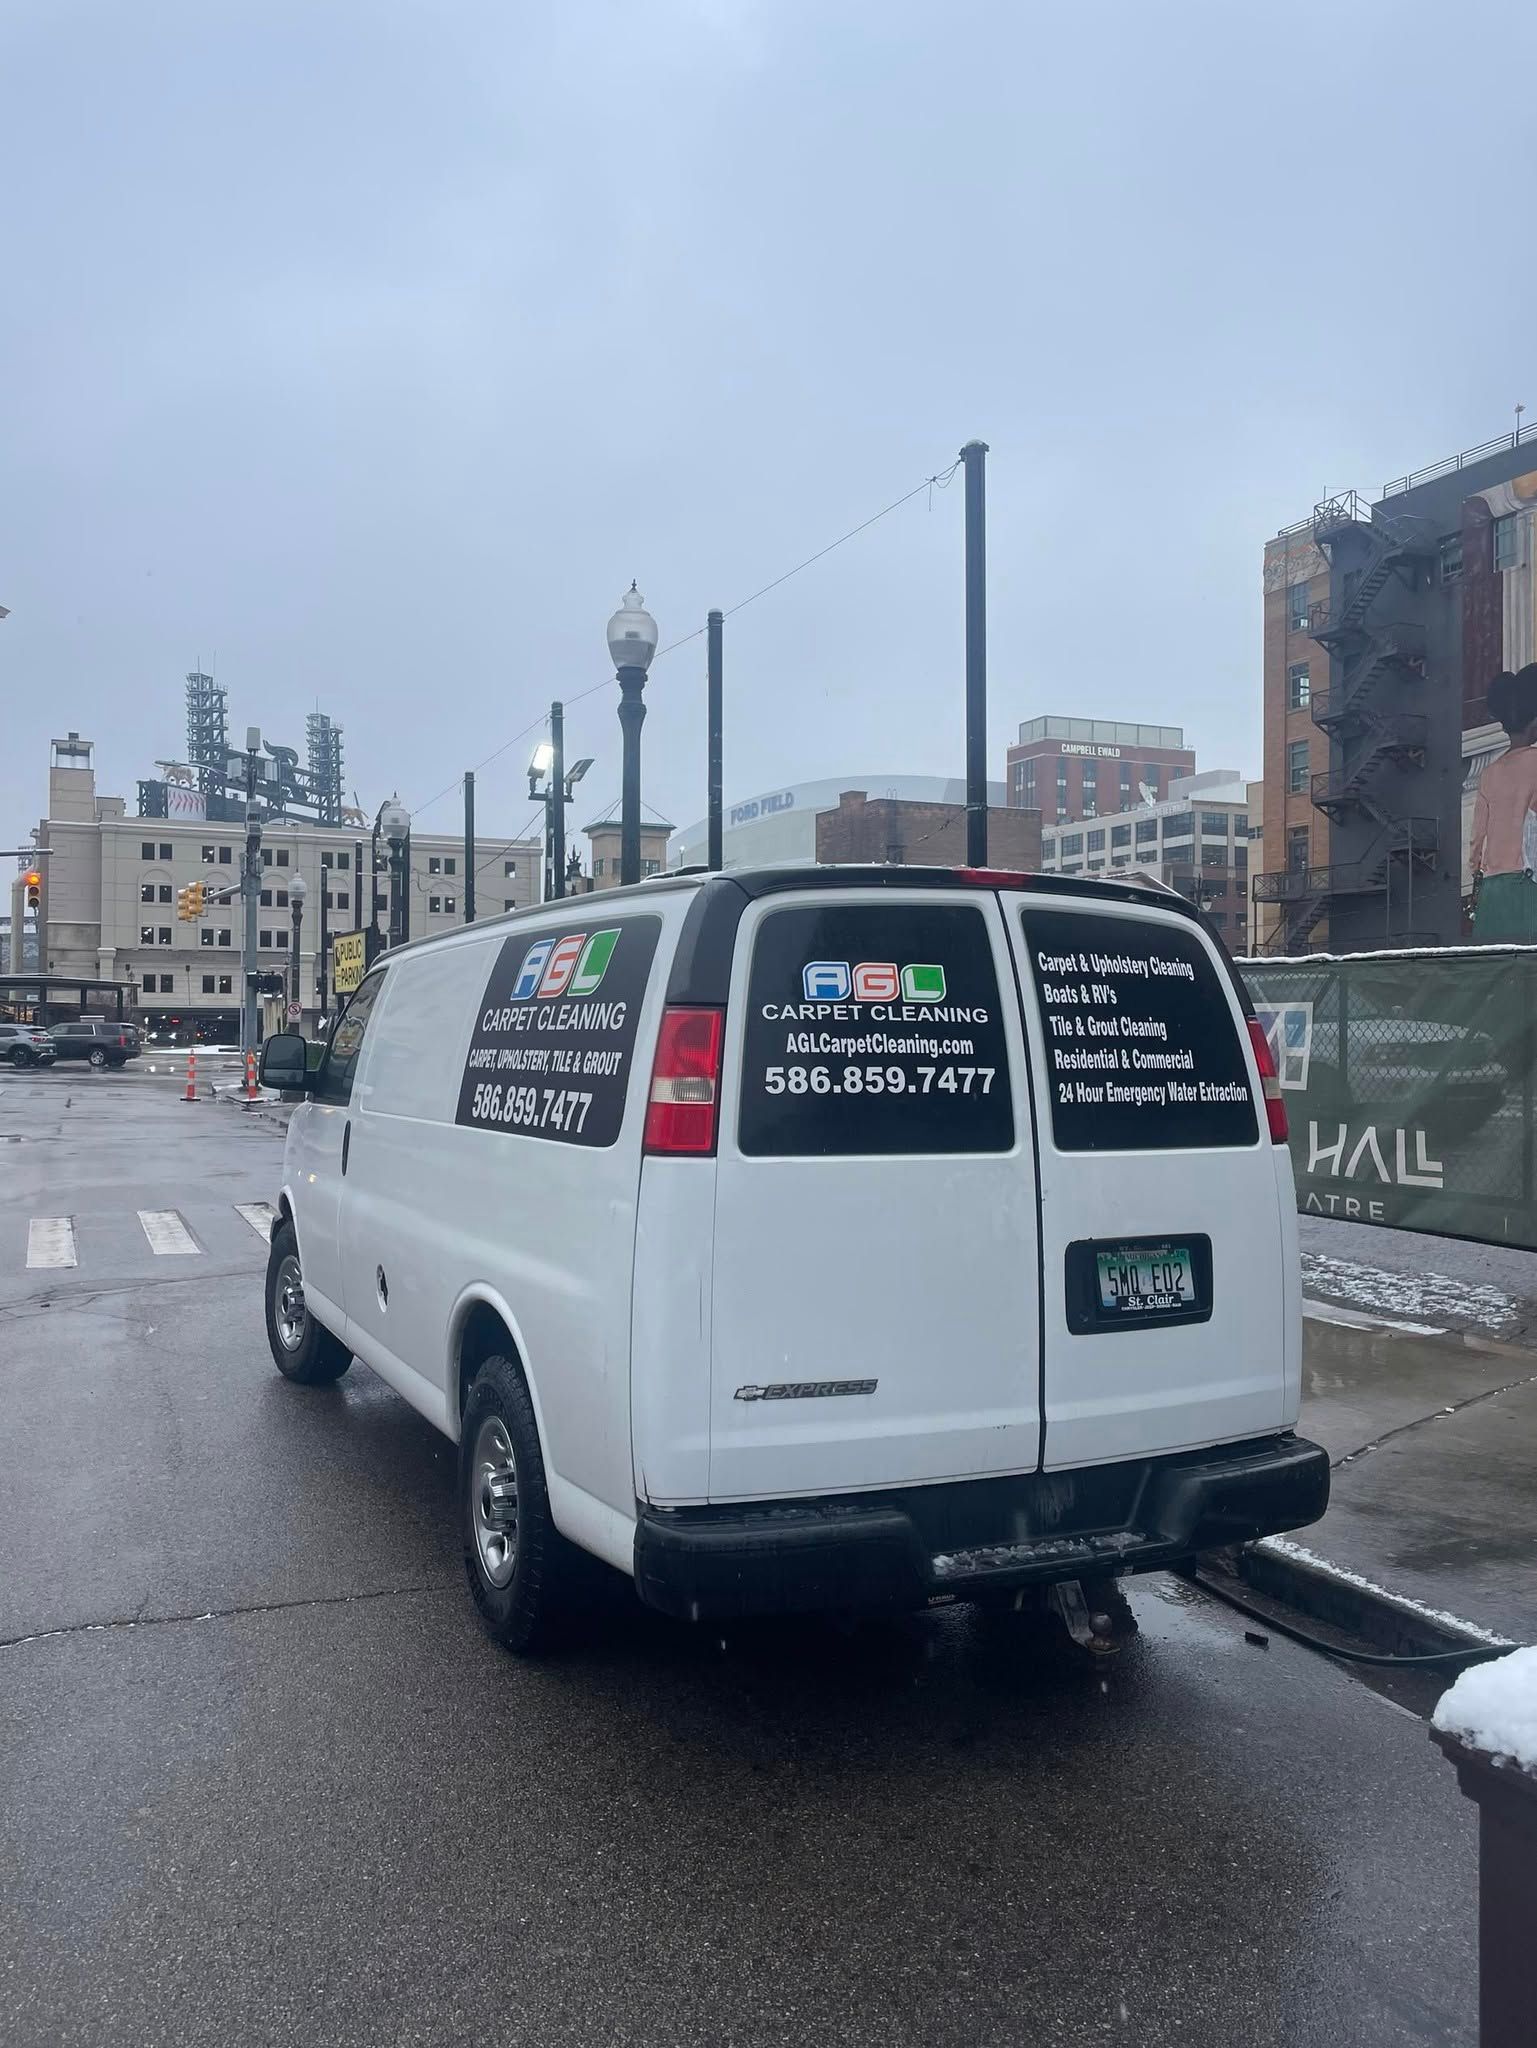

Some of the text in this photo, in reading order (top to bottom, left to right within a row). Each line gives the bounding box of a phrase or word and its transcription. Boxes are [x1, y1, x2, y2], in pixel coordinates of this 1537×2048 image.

[1061, 743, 1120, 757] CAMPBELL EWALD
[340, 939, 362, 961] PUBLIC
[510, 928, 622, 1000] AGL
[1038, 952, 1195, 981] Carpet & Upholstery Cleaning
[802, 961, 947, 1003] AGL
[1043, 983, 1118, 1005] Boats & RV's
[482, 1002, 627, 1032] CARPET CLEANING
[762, 1004, 989, 1024] CARPET CLEANING
[1049, 1015, 1168, 1041] Tile & Grout Cleaning
[786, 1032, 974, 1058] AGLCarpetCleaning.com
[468, 1048, 622, 1076] CARPET, UPHOLSTERY, TILE & GROUT
[1054, 1048, 1195, 1070] Residential & Commercial
[764, 1066, 996, 1095] 586.859.7477
[1058, 1081, 1248, 1107] 24 Hour Emergency Water Extraction
[472, 1083, 593, 1134] 586.859.7477
[1306, 1121, 1444, 1188] HALL
[1128, 1296, 1144, 1307] St.
[1147, 1293, 1174, 1305] Clair
[765, 1379, 878, 1400] EXPRESS
